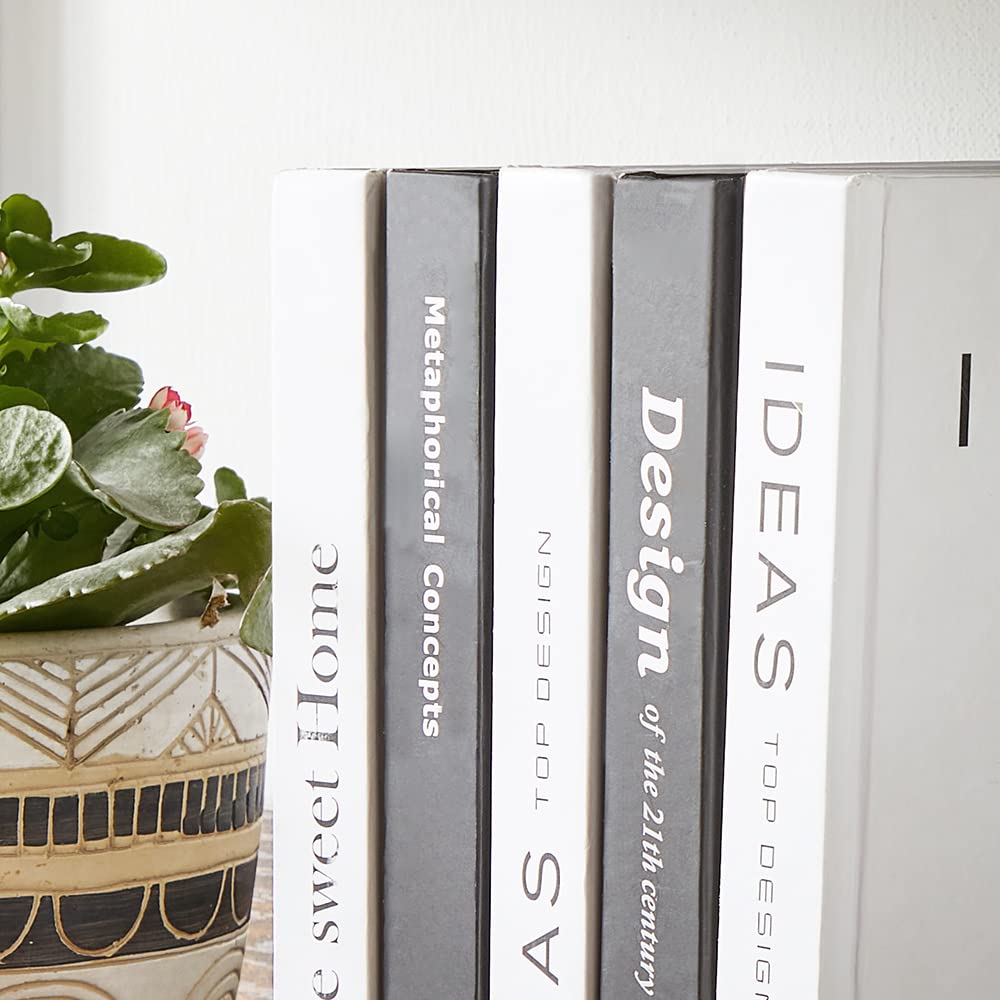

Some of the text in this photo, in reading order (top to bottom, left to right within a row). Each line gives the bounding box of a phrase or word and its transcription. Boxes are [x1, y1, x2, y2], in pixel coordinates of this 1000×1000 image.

[418, 295, 447, 738] Metaphorical Concepts
[754, 356, 806, 692] IDEAS
[296, 543, 340, 747] Home
[536, 530, 553, 703] DESIGN
[624, 386, 686, 998] Design of the 21th century
[305, 768, 340, 945] sweet
[535, 721, 551, 810] TOP
[762, 733, 780, 823] TOP
